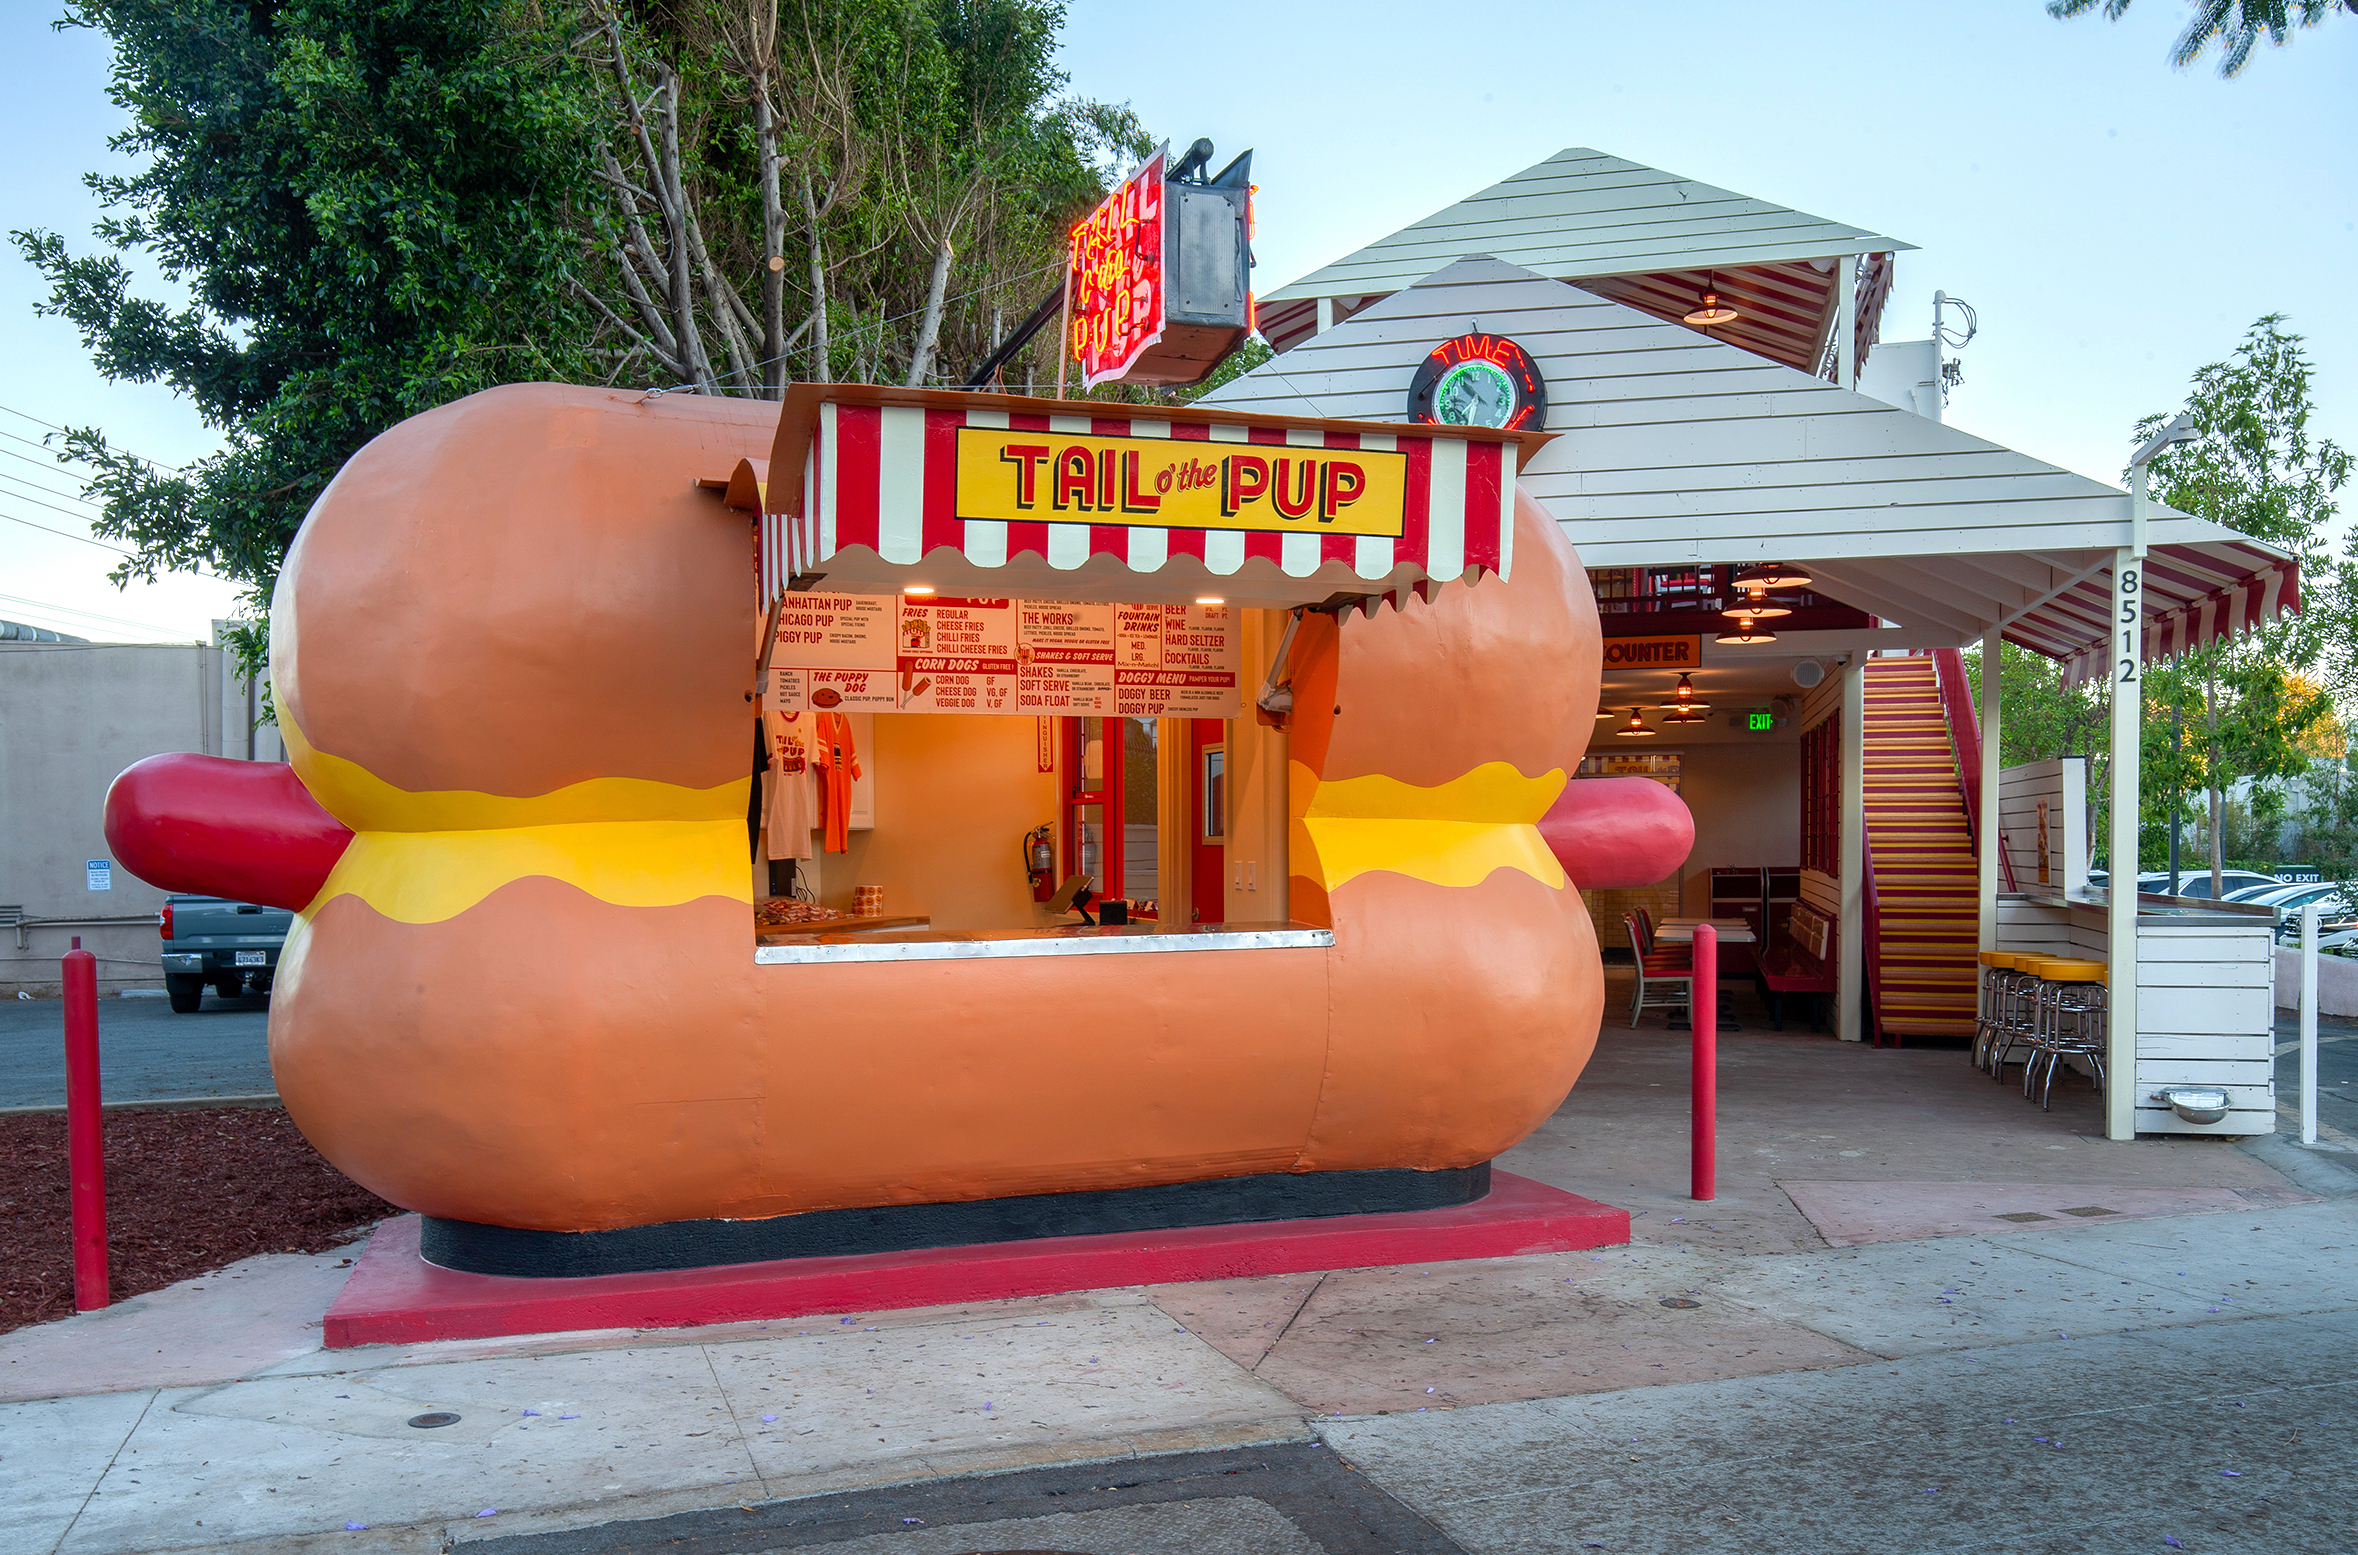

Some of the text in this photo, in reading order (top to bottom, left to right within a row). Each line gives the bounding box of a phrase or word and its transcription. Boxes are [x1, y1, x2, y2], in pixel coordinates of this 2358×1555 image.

[1071, 172, 1158, 272] TAIL
[1074, 278, 1153, 374] PUP
[1000, 444, 1161, 514] TAIL
[1220, 454, 1366, 523] PUP
[782, 598, 852, 611] ANHATTAN PUP
[902, 608, 928, 617] FRIES
[937, 609, 968, 619] REGULAR
[1166, 605, 1186, 615] BEER
[778, 614, 834, 627] HICAGO PUP
[1022, 612, 1073, 625] THE WORKS
[1118, 612, 1160, 621] FOUNTAIN
[937, 621, 984, 631] CHEESE FRIES
[1123, 622, 1159, 632] DRINKS
[1166, 619, 1186, 630] WINE
[2119, 570, 2138, 682] 8512
[775, 631, 822, 644] PIGGY PUP
[937, 632, 980, 642] CHILLI FRIES
[1166, 634, 1224, 647] HARD SELTZER
[937, 644, 958, 653] CHILLI
[960, 644, 986, 654] CHEESE
[988, 645, 1008, 654] FRIES
[1131, 641, 1146, 650] MED.
[1036, 652, 1064, 660] SHAKES
[1132, 653, 1145, 661] LRG.
[1165, 653, 1209, 665] COCKTAILS
[915, 658, 979, 671] CORN DOGS
[813, 672, 869, 682] THE PUPPY
[1020, 666, 1053, 678] SHAKES
[936, 676, 969, 685] CORN DOG
[987, 677, 995, 685] GF
[1118, 672, 1154, 683] DOGGY
[1156, 673, 1186, 684] MENU
[844, 683, 866, 693] DOG
[1020, 680, 1069, 691] SOFT SERVE
[936, 687, 976, 696] CHEESE DOG
[999, 688, 1008, 696] GF
[1119, 688, 1170, 700] DOGGY BEER
[936, 698, 975, 708] VEGGIE DOG
[994, 699, 1002, 708] GF
[1020, 695, 1070, 706] SODA FLOAT
[1119, 703, 1164, 714] DOGGY PUP
[1750, 714, 1772, 730] EXIT
[783, 746, 804, 756] PUP
[2274, 874, 2319, 882] NO EXIT
